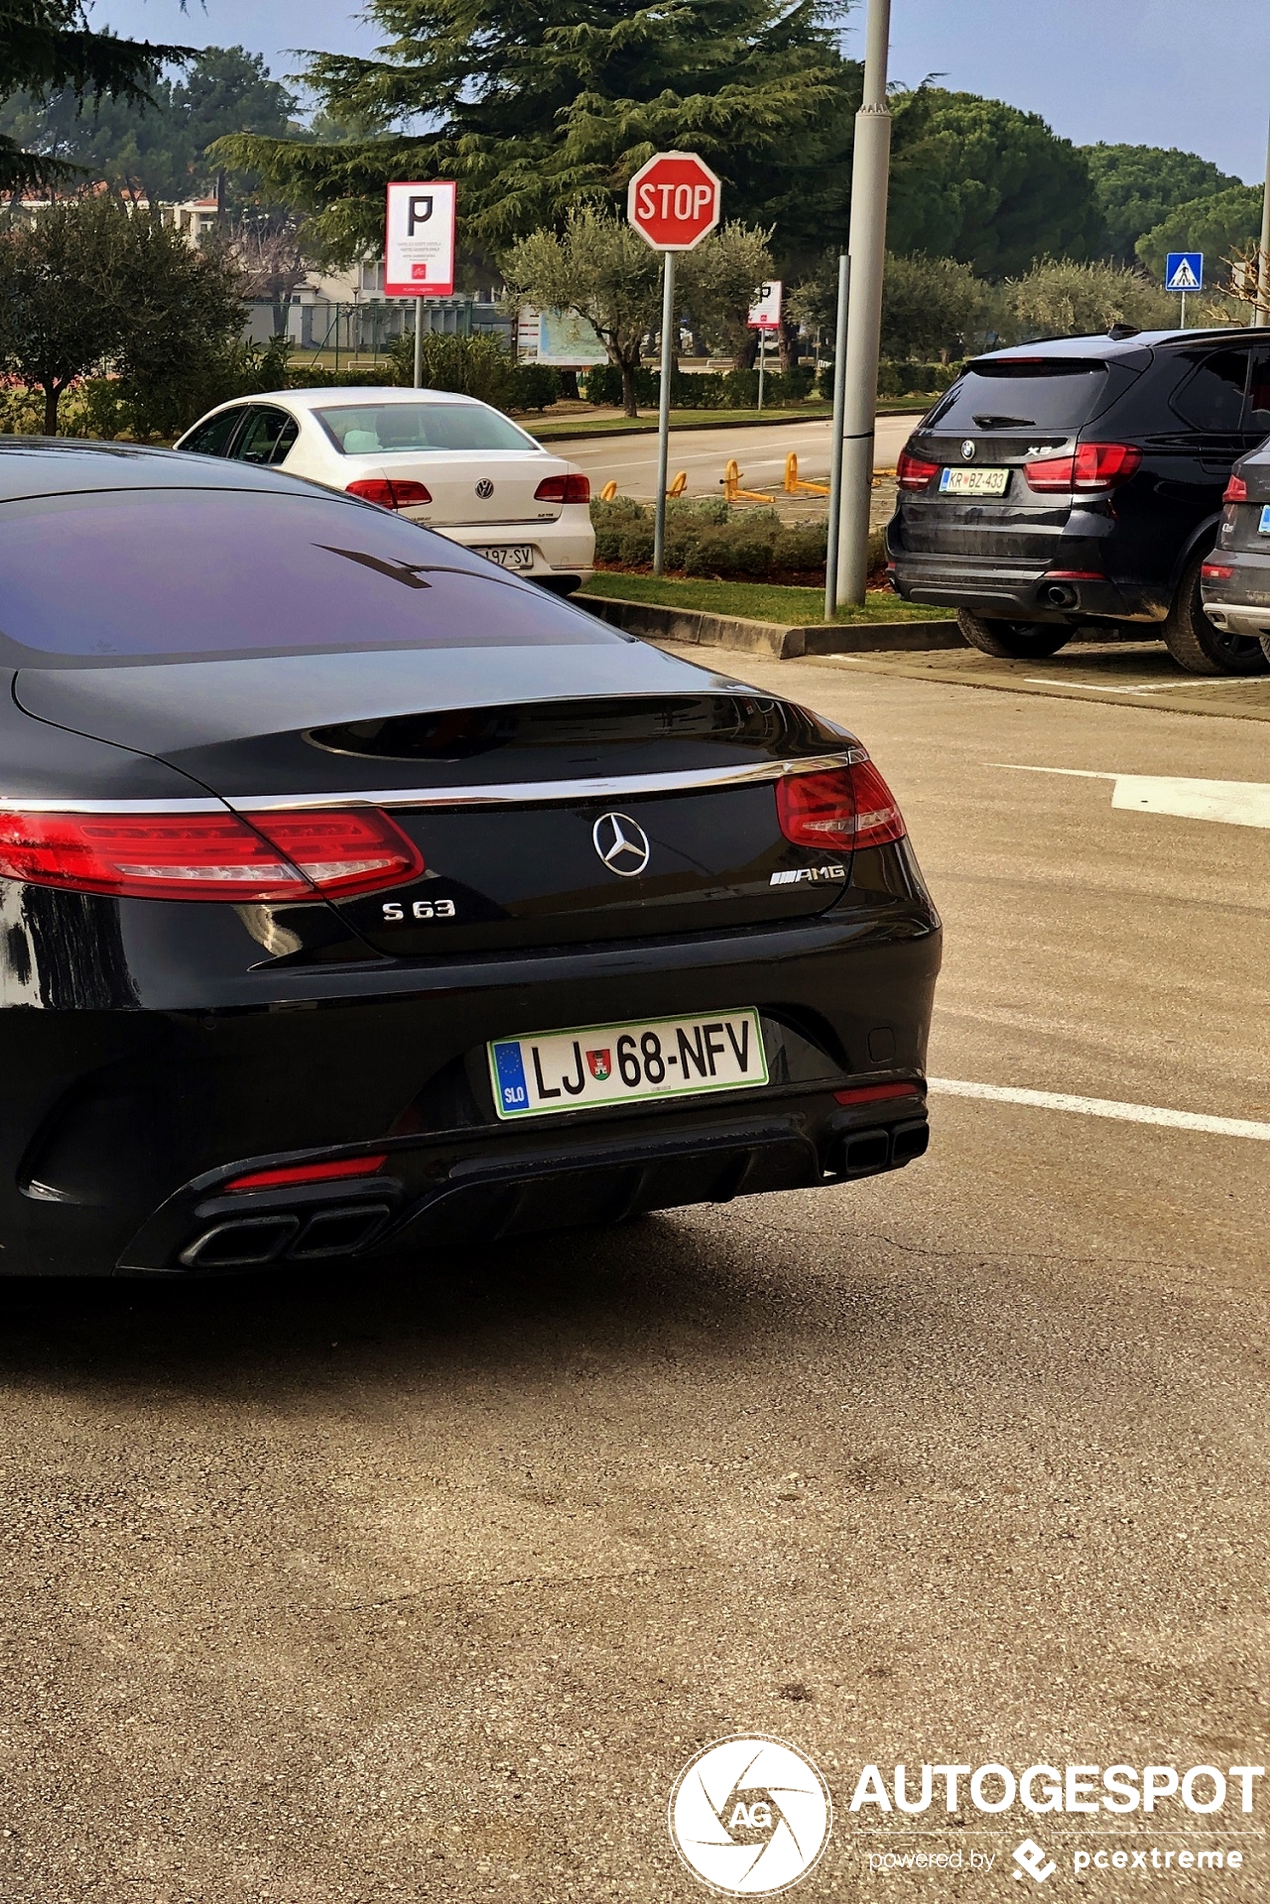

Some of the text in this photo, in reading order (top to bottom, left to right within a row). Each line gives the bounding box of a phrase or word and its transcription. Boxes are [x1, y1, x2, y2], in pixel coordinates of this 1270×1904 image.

[638, 183, 712, 220] STOP
[407, 195, 434, 237] P
[759, 286, 772, 304] P
[1024, 446, 1053, 456] X5
[948, 472, 1004, 489] KR BZ-433
[795, 865, 845, 883] AMG
[382, 899, 456, 921] S 63
[531, 1020, 749, 1099] LJ 68-NFV
[504, 1086, 525, 1104] SLO
